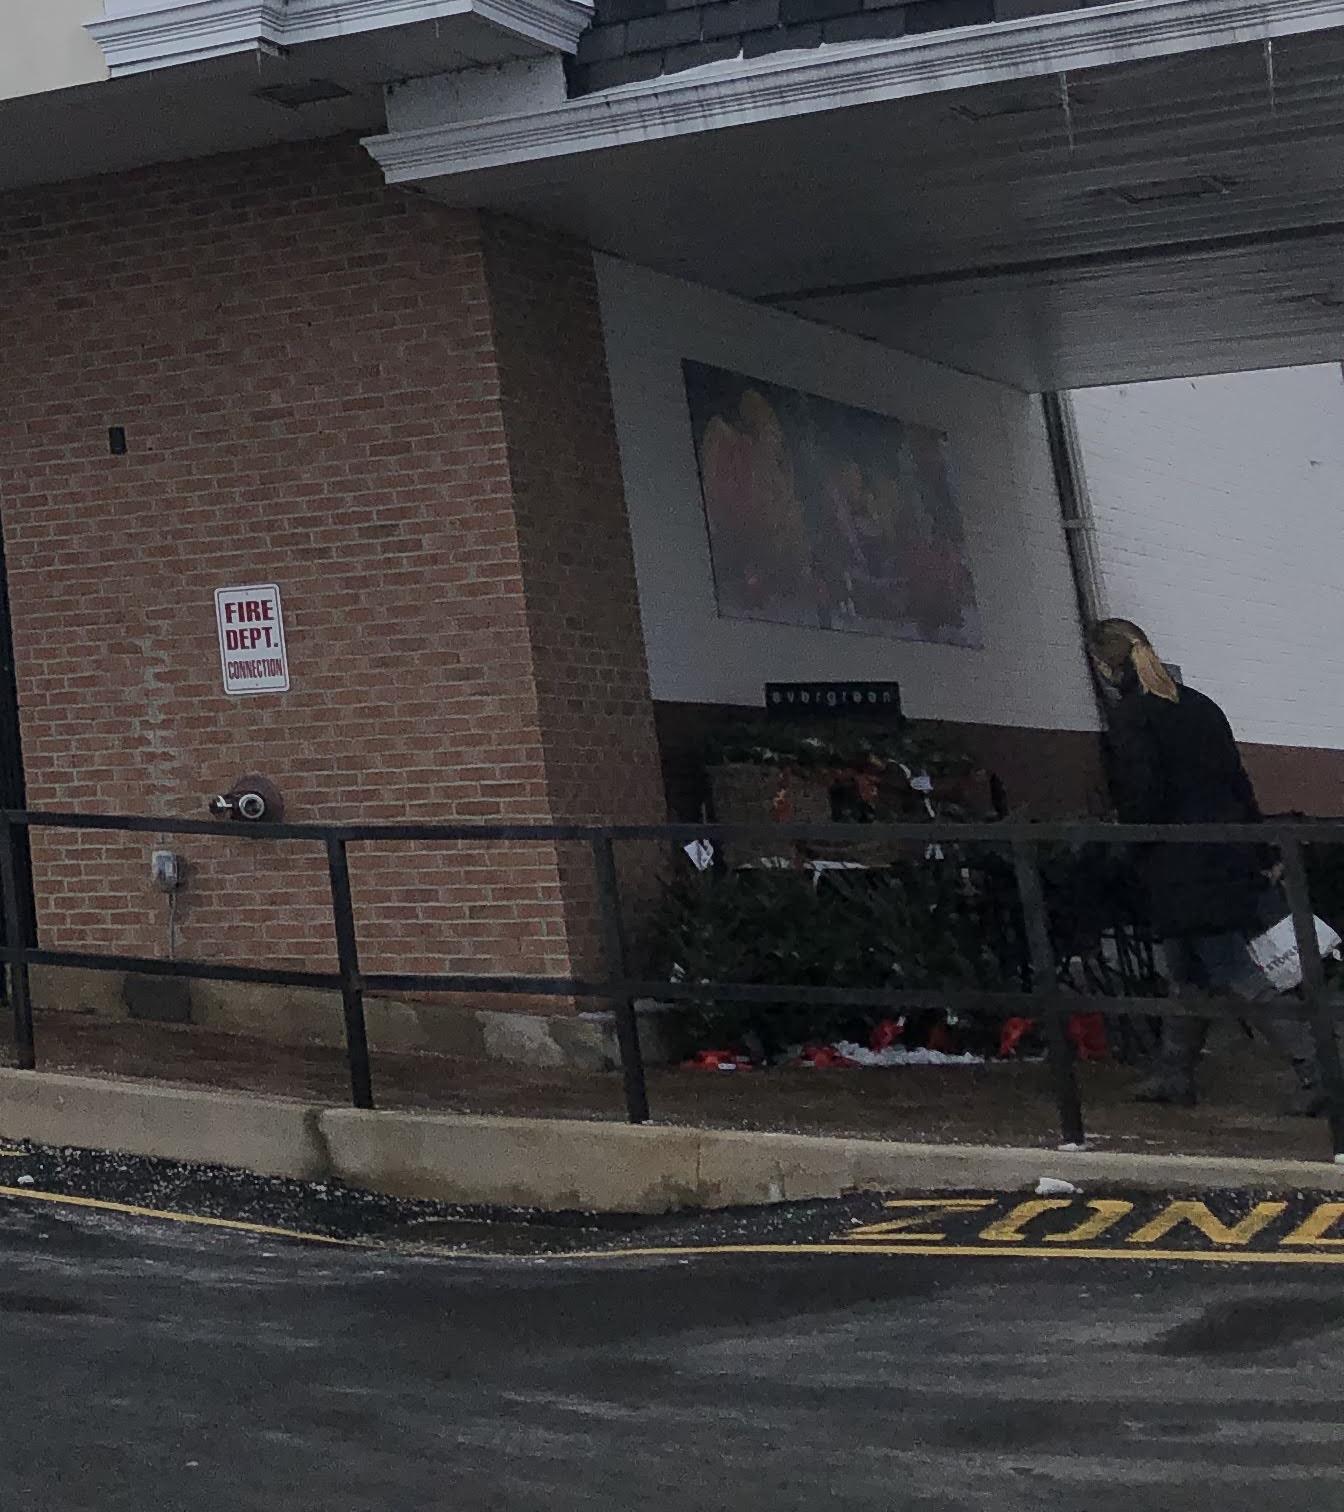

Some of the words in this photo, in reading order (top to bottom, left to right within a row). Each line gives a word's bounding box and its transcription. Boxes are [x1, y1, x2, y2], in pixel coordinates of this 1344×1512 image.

[224, 599, 274, 624] FIRE
[225, 626, 279, 651] DEPT.
[227, 658, 283, 680] CONNECTION
